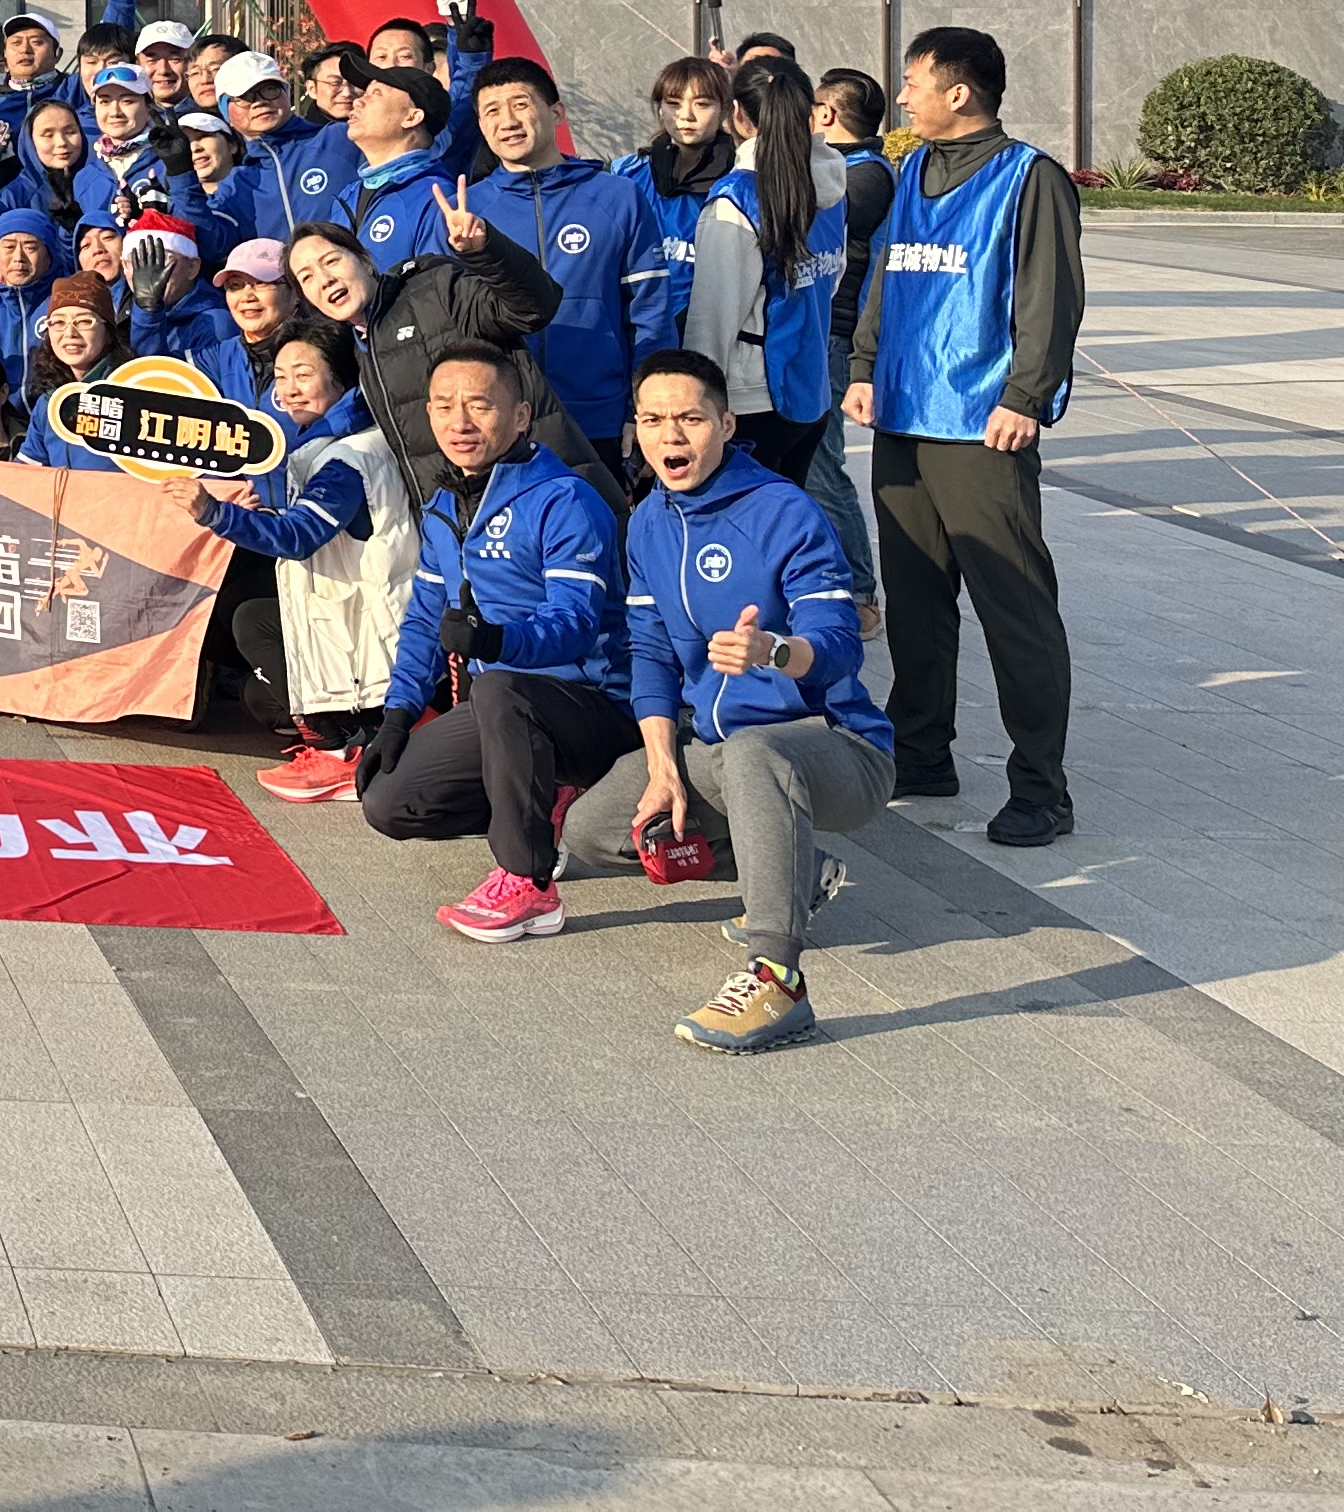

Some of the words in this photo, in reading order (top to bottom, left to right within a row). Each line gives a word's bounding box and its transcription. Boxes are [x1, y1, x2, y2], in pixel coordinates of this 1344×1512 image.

[886, 242, 970, 274] 蓝城物业
[78, 393, 124, 420] 黑暗
[75, 414, 121, 442] 跑团
[138, 408, 251, 458] 江阴站
